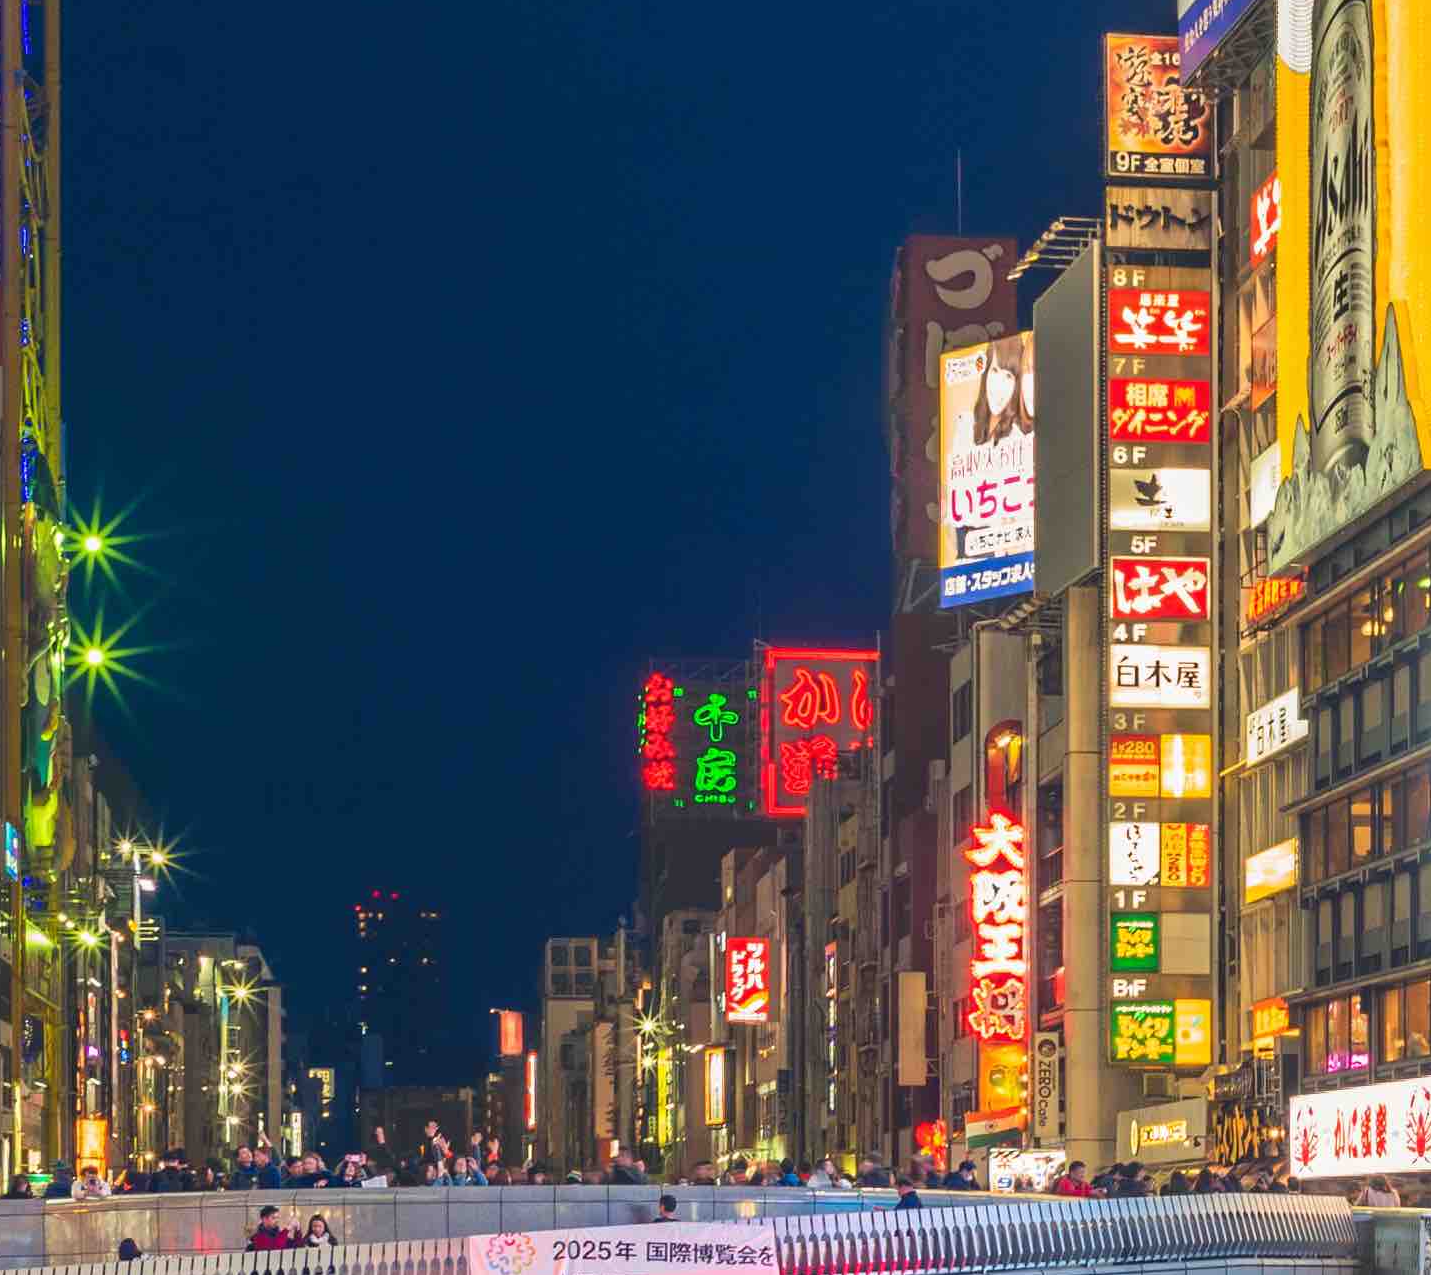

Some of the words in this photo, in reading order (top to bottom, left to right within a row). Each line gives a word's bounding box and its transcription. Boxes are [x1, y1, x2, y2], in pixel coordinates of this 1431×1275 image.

[1116, 152, 1141, 172] 9F
[1113, 269, 1145, 287] 8F
[1113, 357, 1146, 375] 7F
[1125, 383, 1169, 408] 相席
[1112, 407, 1210, 438] ダイニング
[1113, 445, 1147, 464] 6F
[1130, 535, 1157, 554] 5F
[1113, 623, 1146, 643] 4F
[1115, 656, 1203, 691] 白木屋
[1114, 713, 1146, 731] 3F
[694, 693, 739, 792] 千房
[1114, 802, 1146, 819] 2F
[1114, 890, 1147, 908] 1F
[968, 814, 1025, 1039] 大阪王将
[1113, 979, 1146, 997] B1F
[553, 1239, 636, 1262] 2025年
[646, 1240, 774, 1267] 国際博覧会を
